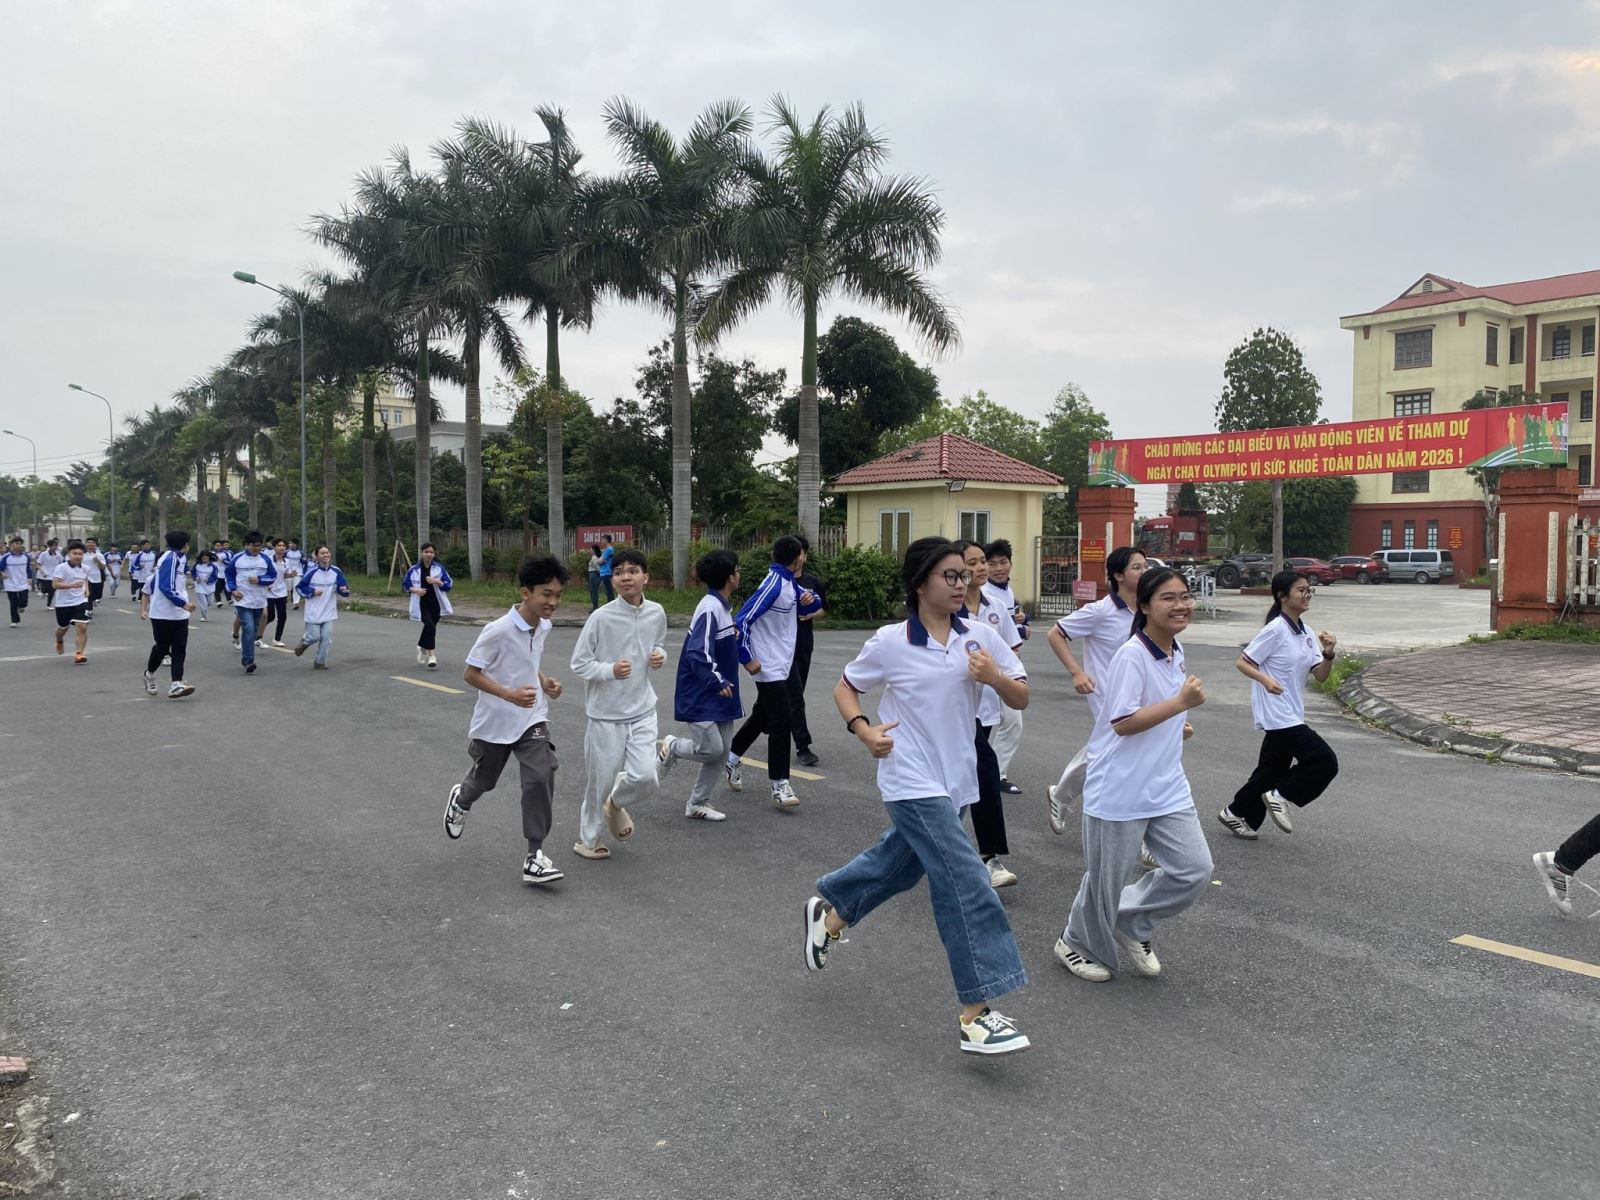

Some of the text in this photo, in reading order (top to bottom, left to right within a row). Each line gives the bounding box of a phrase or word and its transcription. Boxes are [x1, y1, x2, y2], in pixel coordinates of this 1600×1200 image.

[1144, 418, 1471, 458] CHÀO MỪNG CÁC ĐẠI BIỂU VÀ VẬN ĐỘNG VIÊN VỀ THAM DỰ
[1146, 448, 1463, 482] NGÀY CHẠY OLYMPIC VÌ SỨC KHOẺ TOÀN DÂN NĂM 2026 !
